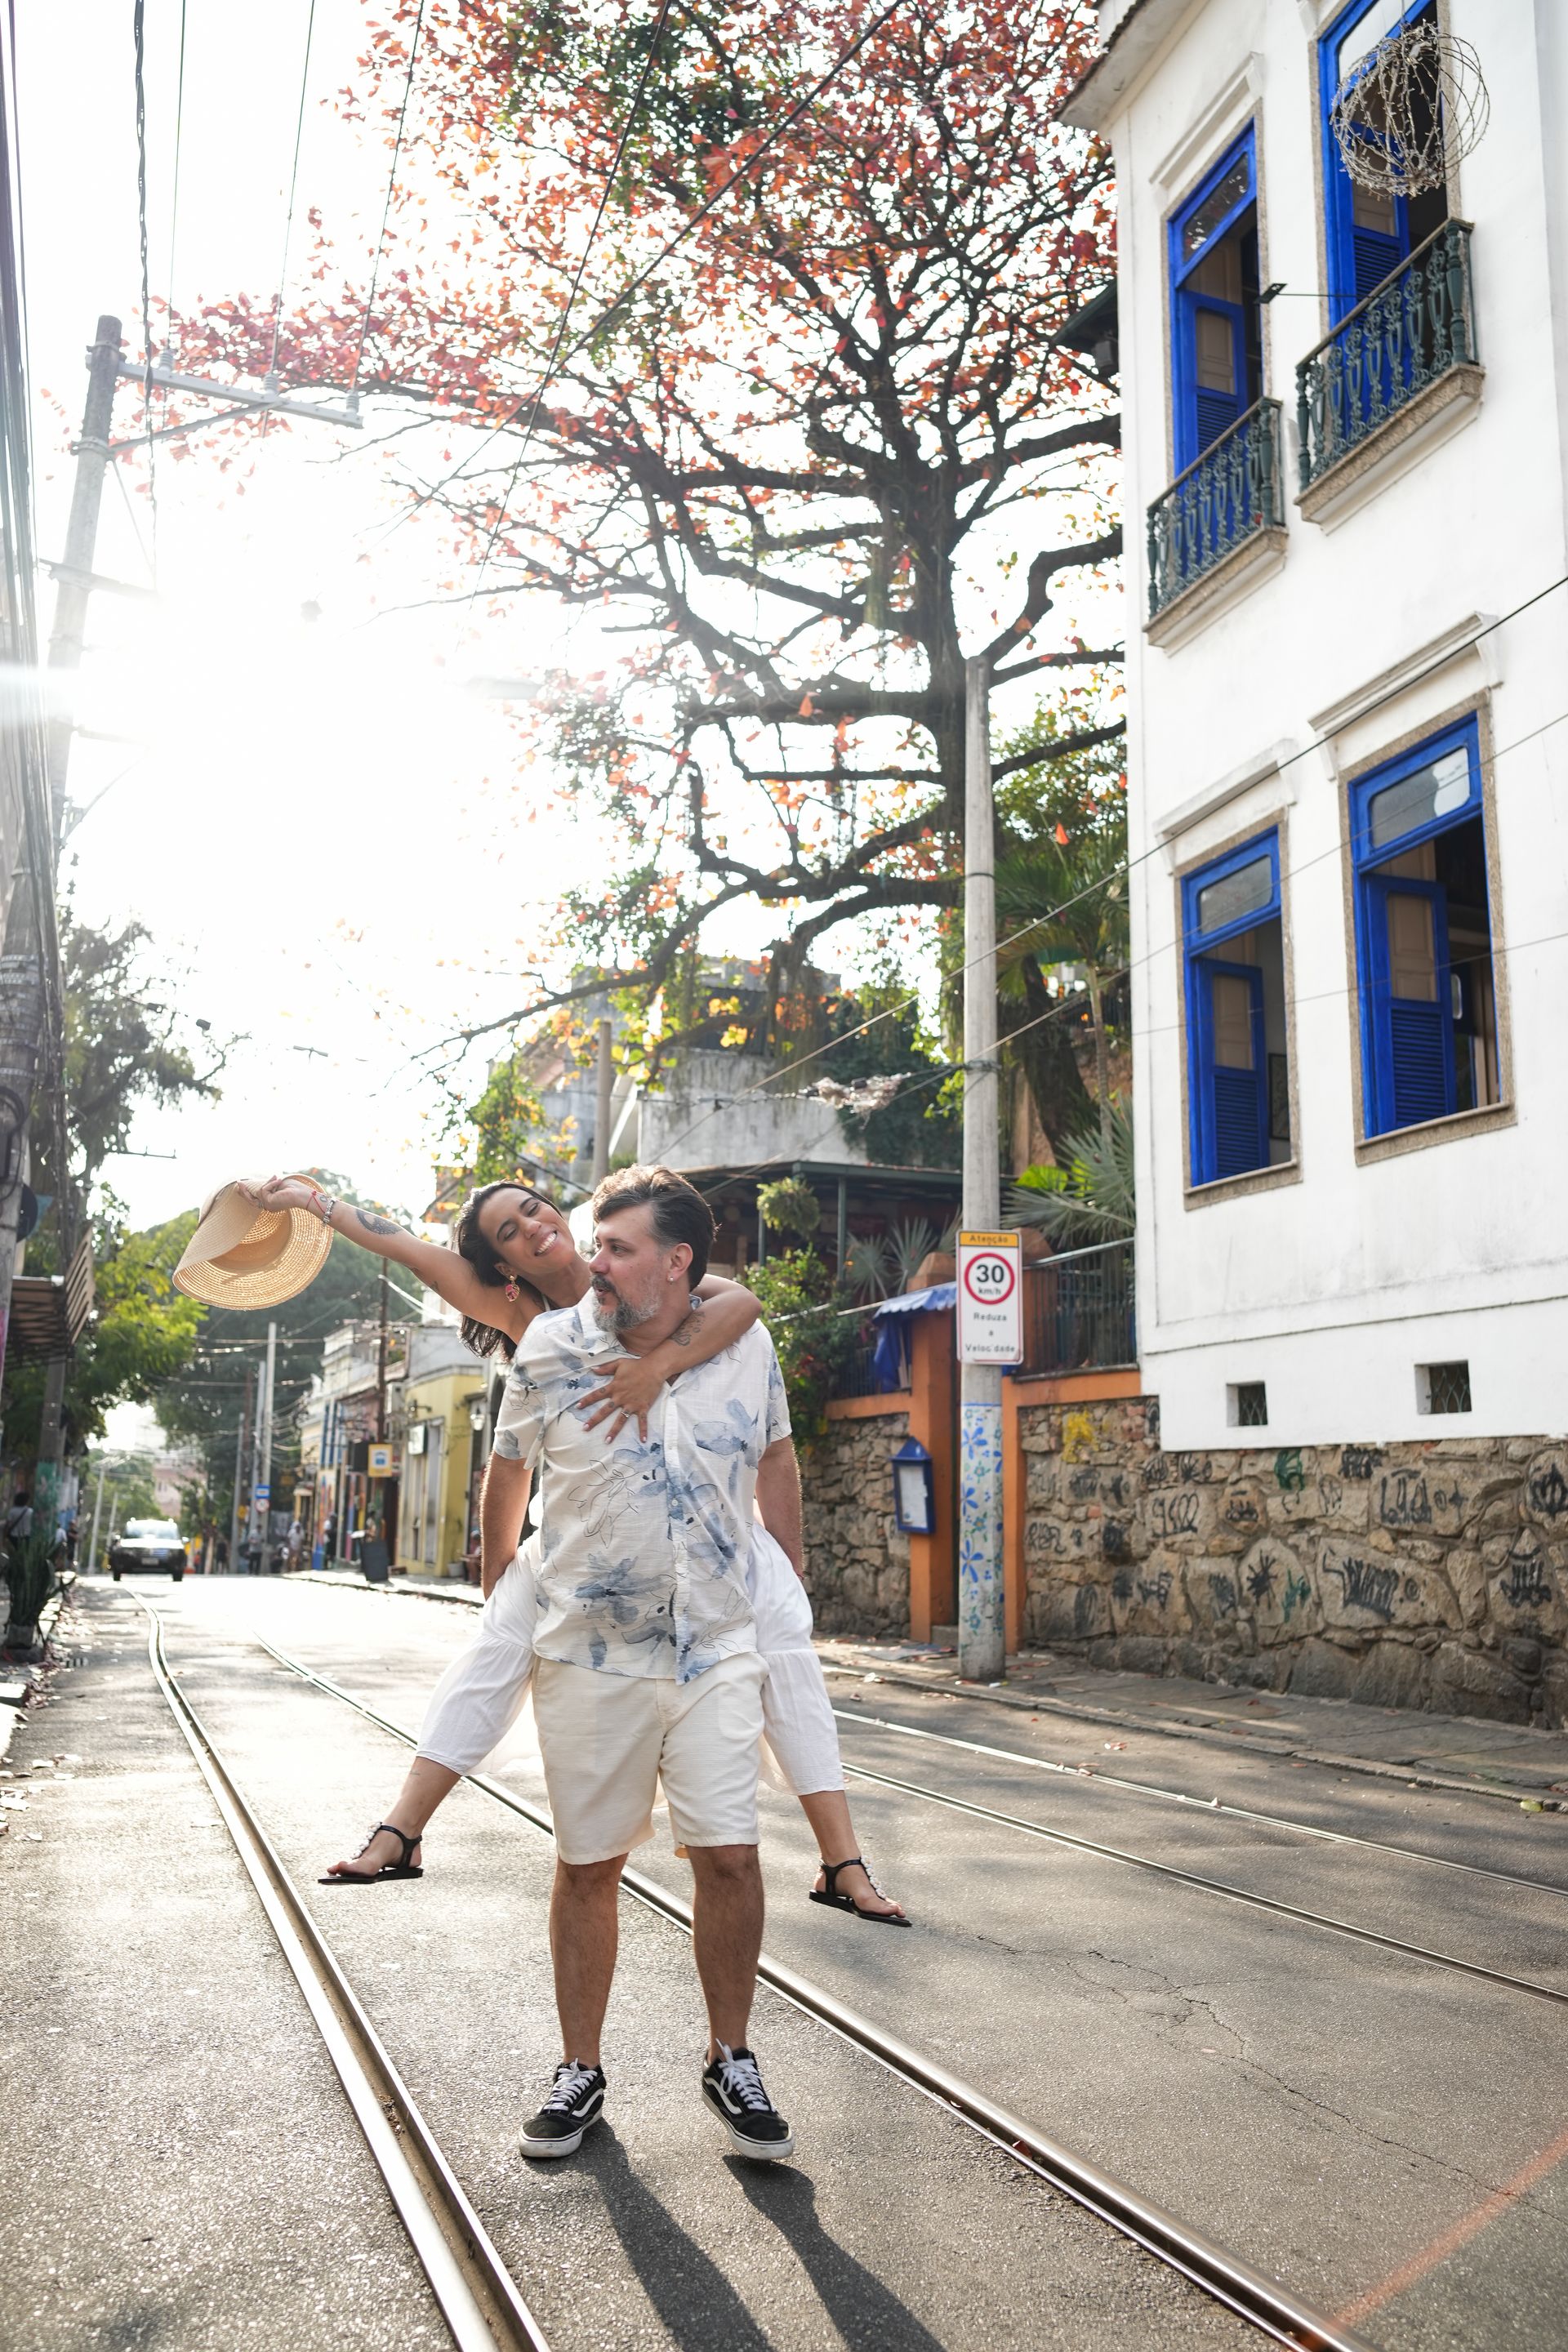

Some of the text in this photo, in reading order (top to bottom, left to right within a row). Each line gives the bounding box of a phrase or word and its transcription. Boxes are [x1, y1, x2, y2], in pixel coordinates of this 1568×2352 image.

[969, 1234, 1008, 1244] Atenção
[976, 1264, 1004, 1283] 30
[978, 1287, 1001, 1295] km/h
[973, 1312, 1007, 1321] Reduza
